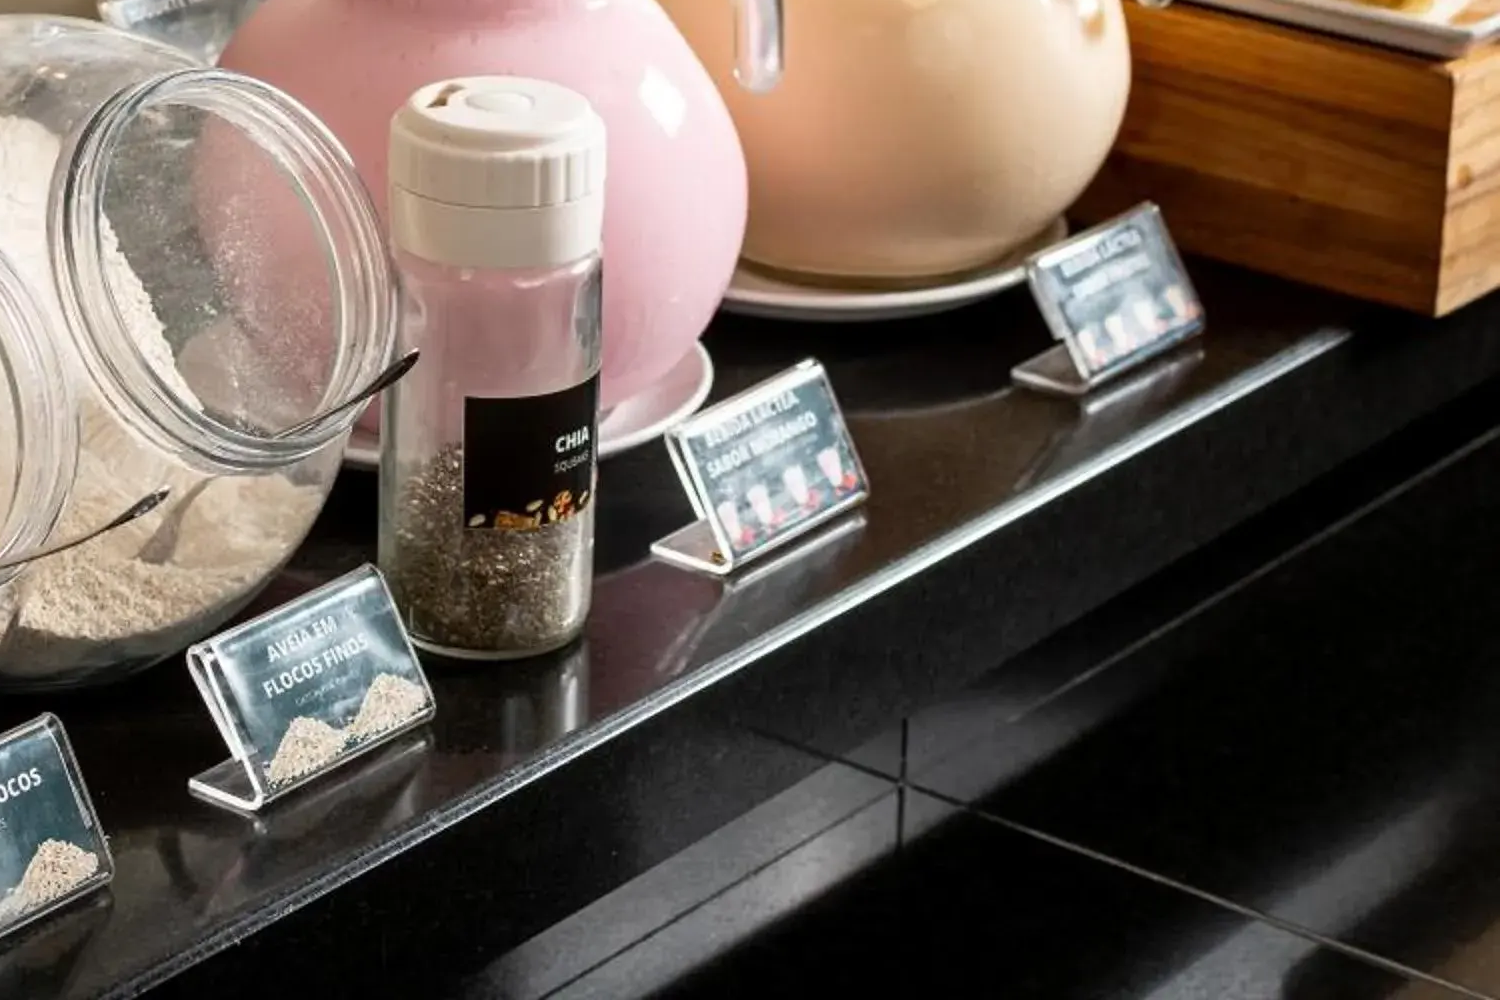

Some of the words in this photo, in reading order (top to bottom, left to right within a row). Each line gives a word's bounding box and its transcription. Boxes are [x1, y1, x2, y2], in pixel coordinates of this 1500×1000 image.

[555, 426, 589, 453] CHIA
[266, 629, 311, 664] AVEIA
[311, 615, 339, 639] EM
[262, 656, 323, 699] FLOCOS
